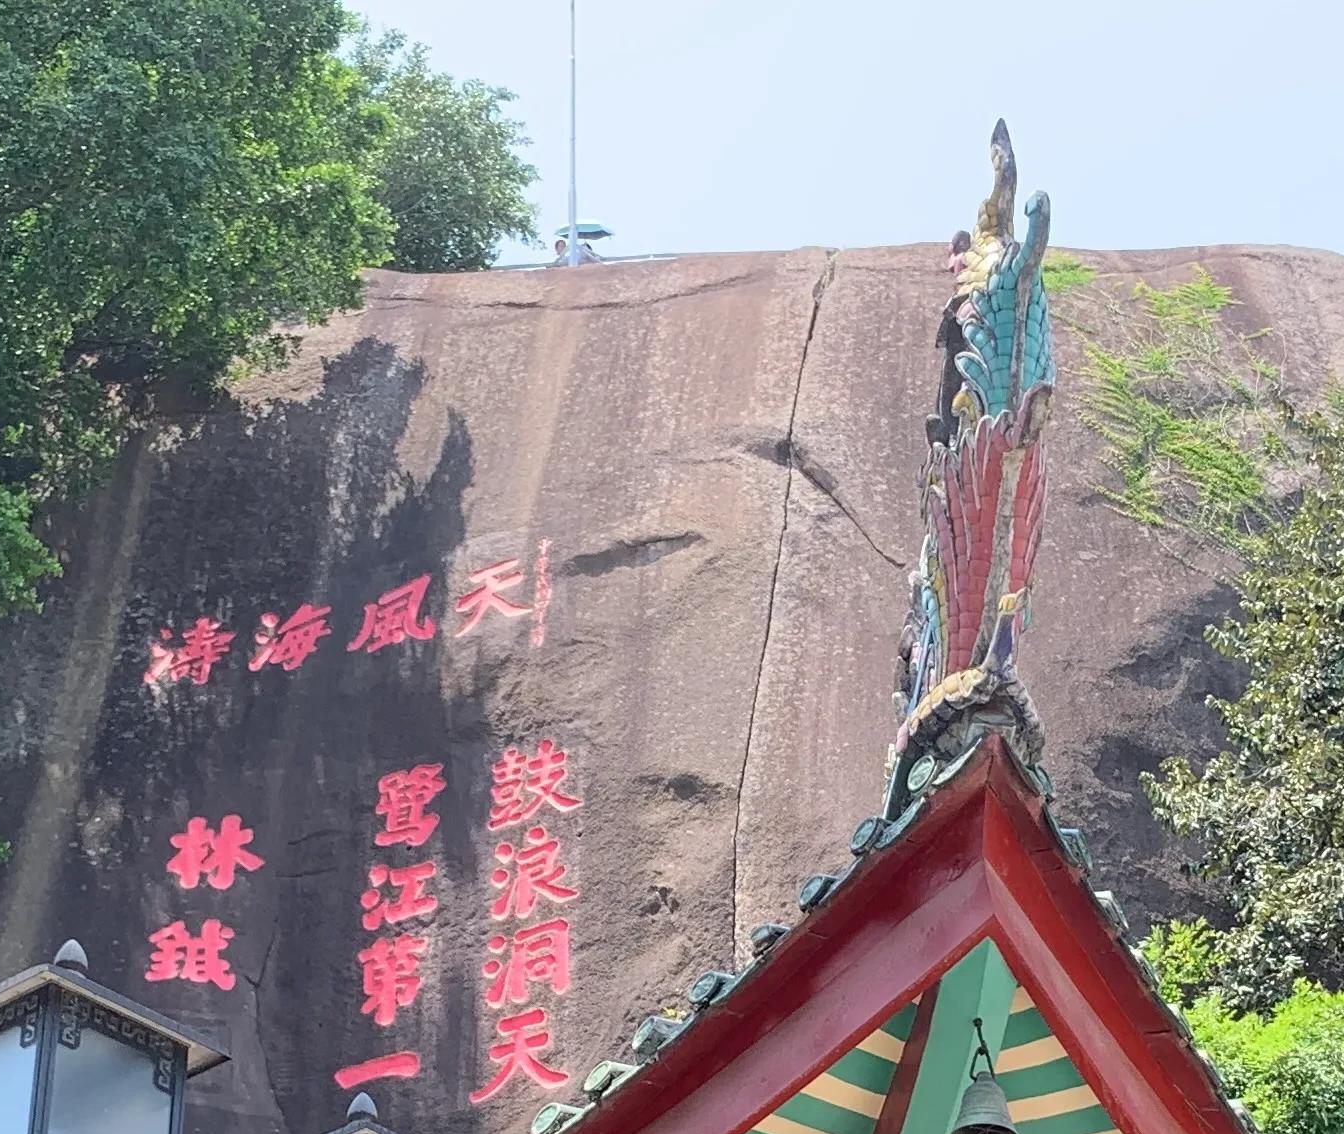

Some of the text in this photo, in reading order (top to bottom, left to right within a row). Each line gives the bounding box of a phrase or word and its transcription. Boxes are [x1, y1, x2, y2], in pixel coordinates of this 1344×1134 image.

[143, 557, 533, 686] 天風海濤
[469, 739, 582, 1104] 鼓浪洞天
